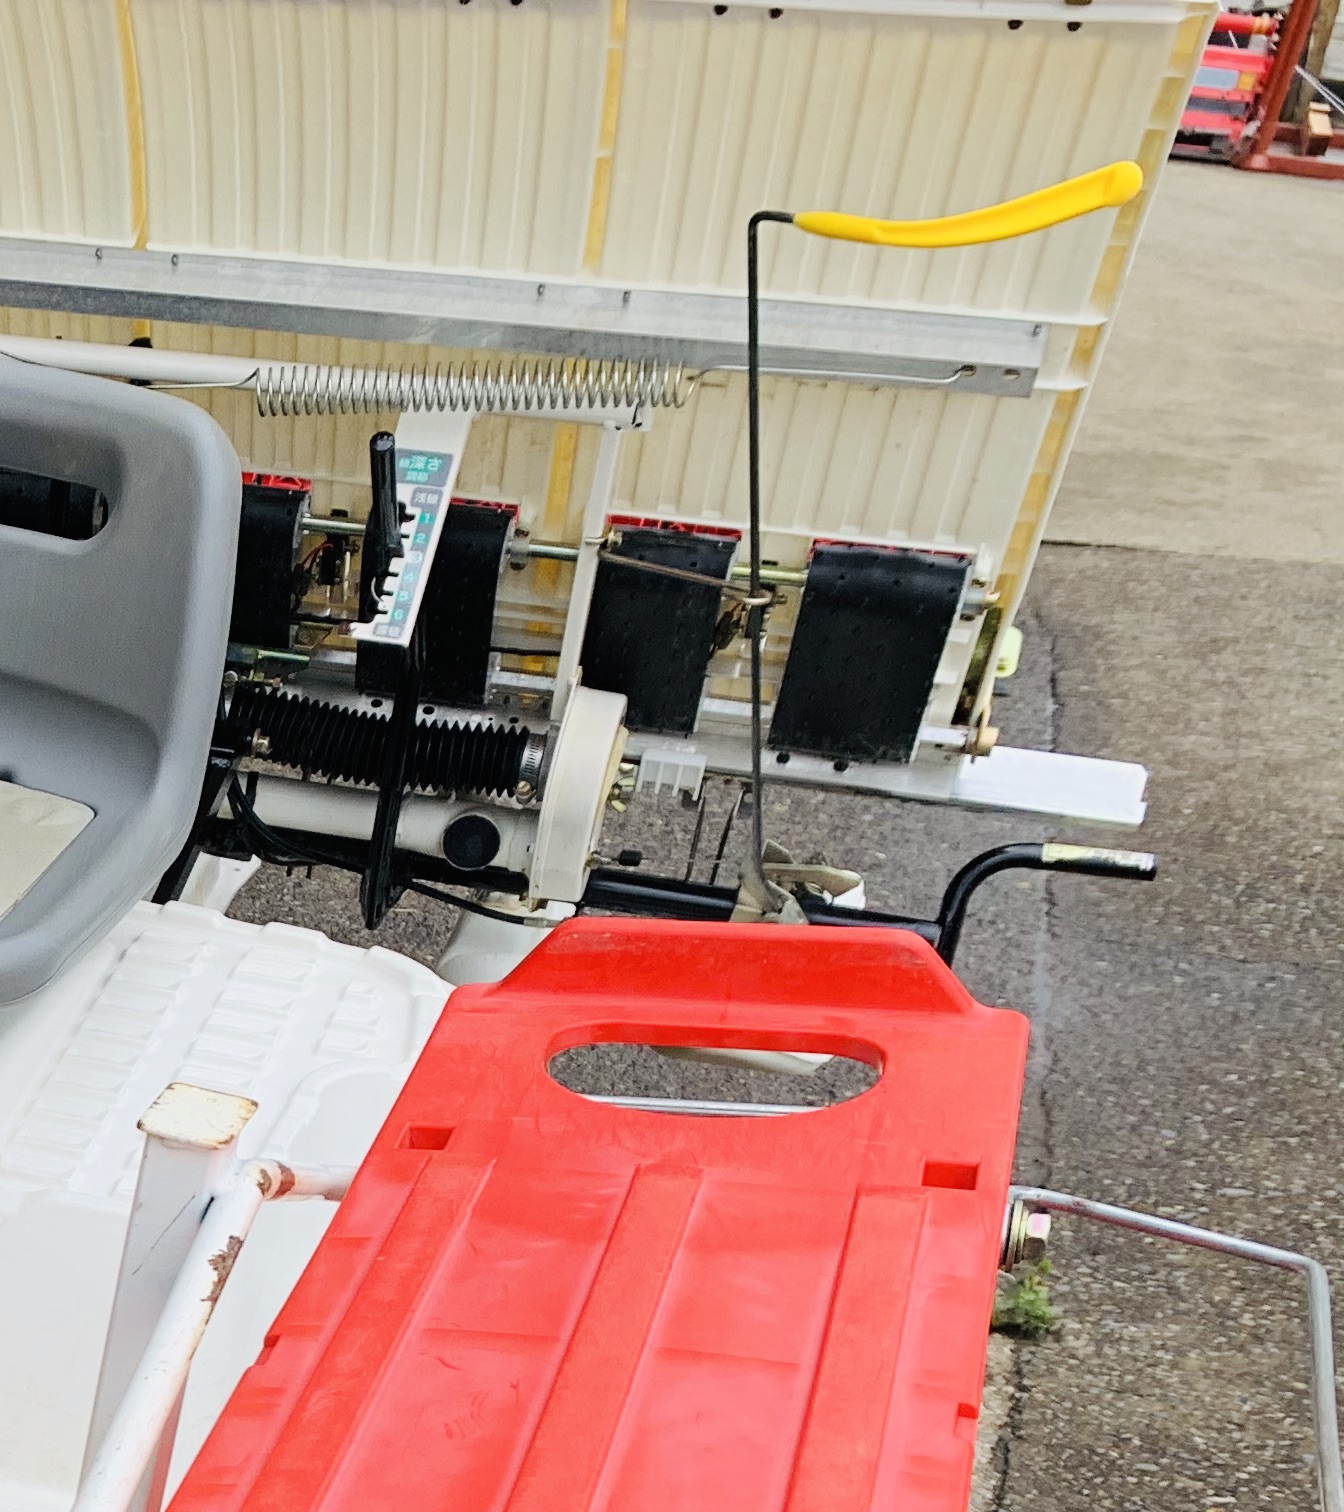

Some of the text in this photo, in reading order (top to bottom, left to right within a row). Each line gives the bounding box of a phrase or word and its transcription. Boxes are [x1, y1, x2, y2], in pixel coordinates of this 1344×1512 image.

[415, 533, 427, 545] 2
[398, 590, 409, 601] 5
[394, 609, 405, 620] 6
